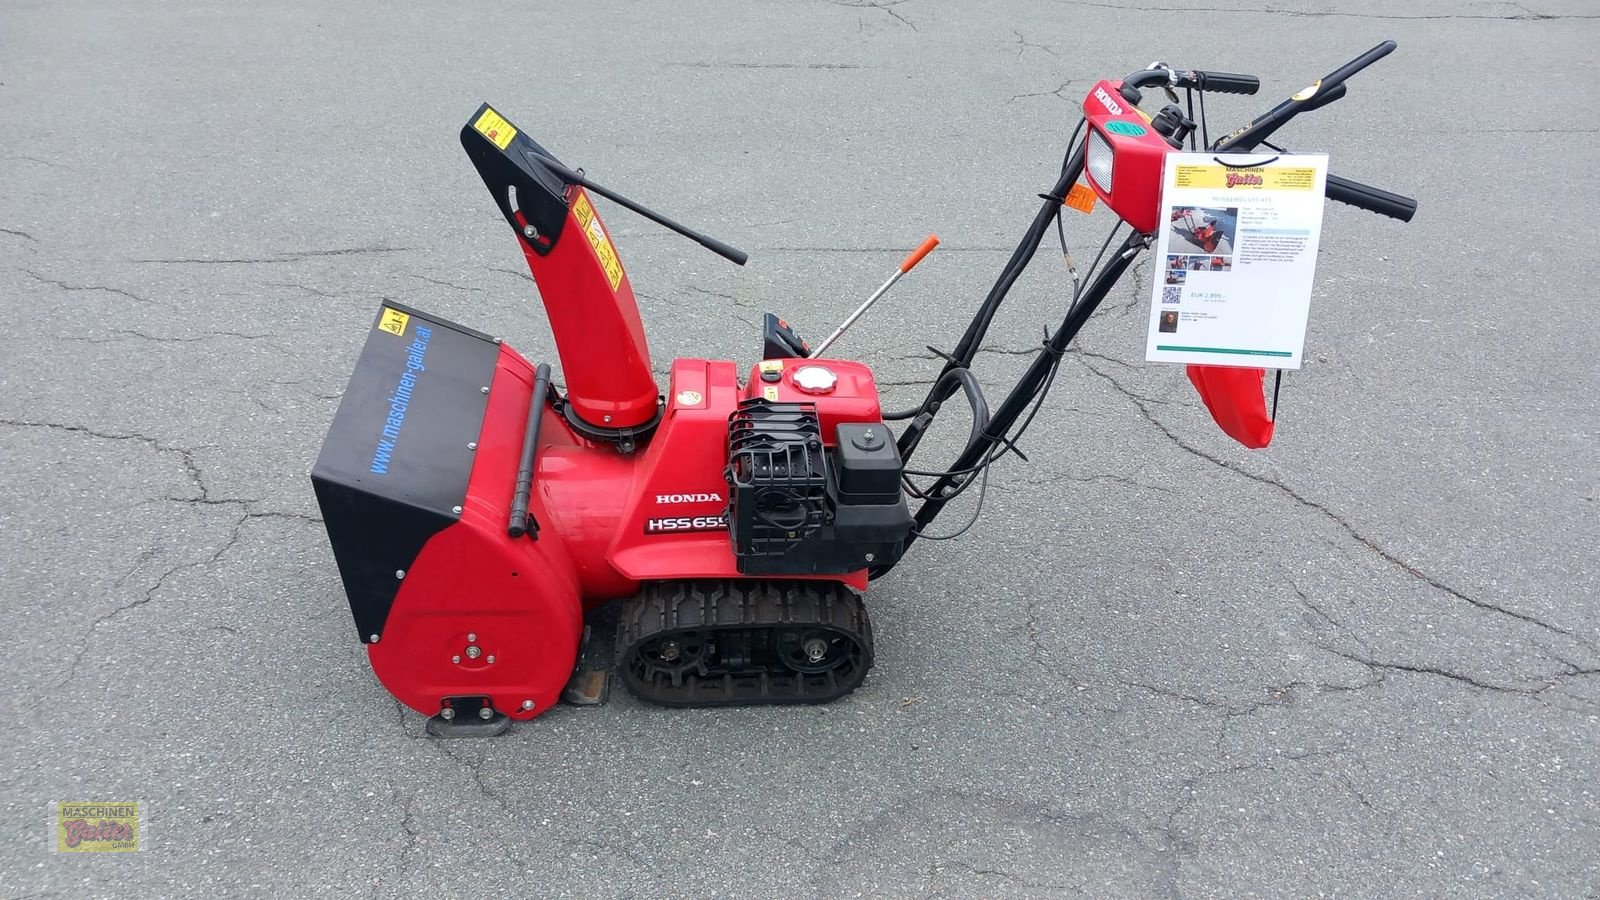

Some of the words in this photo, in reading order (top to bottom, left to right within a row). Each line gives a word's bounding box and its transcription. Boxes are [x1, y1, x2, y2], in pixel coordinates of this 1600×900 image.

[1094, 86, 1123, 116] HONDA
[370, 325, 432, 475] www.maschinen-gailer.at
[656, 493, 722, 504] HONDA
